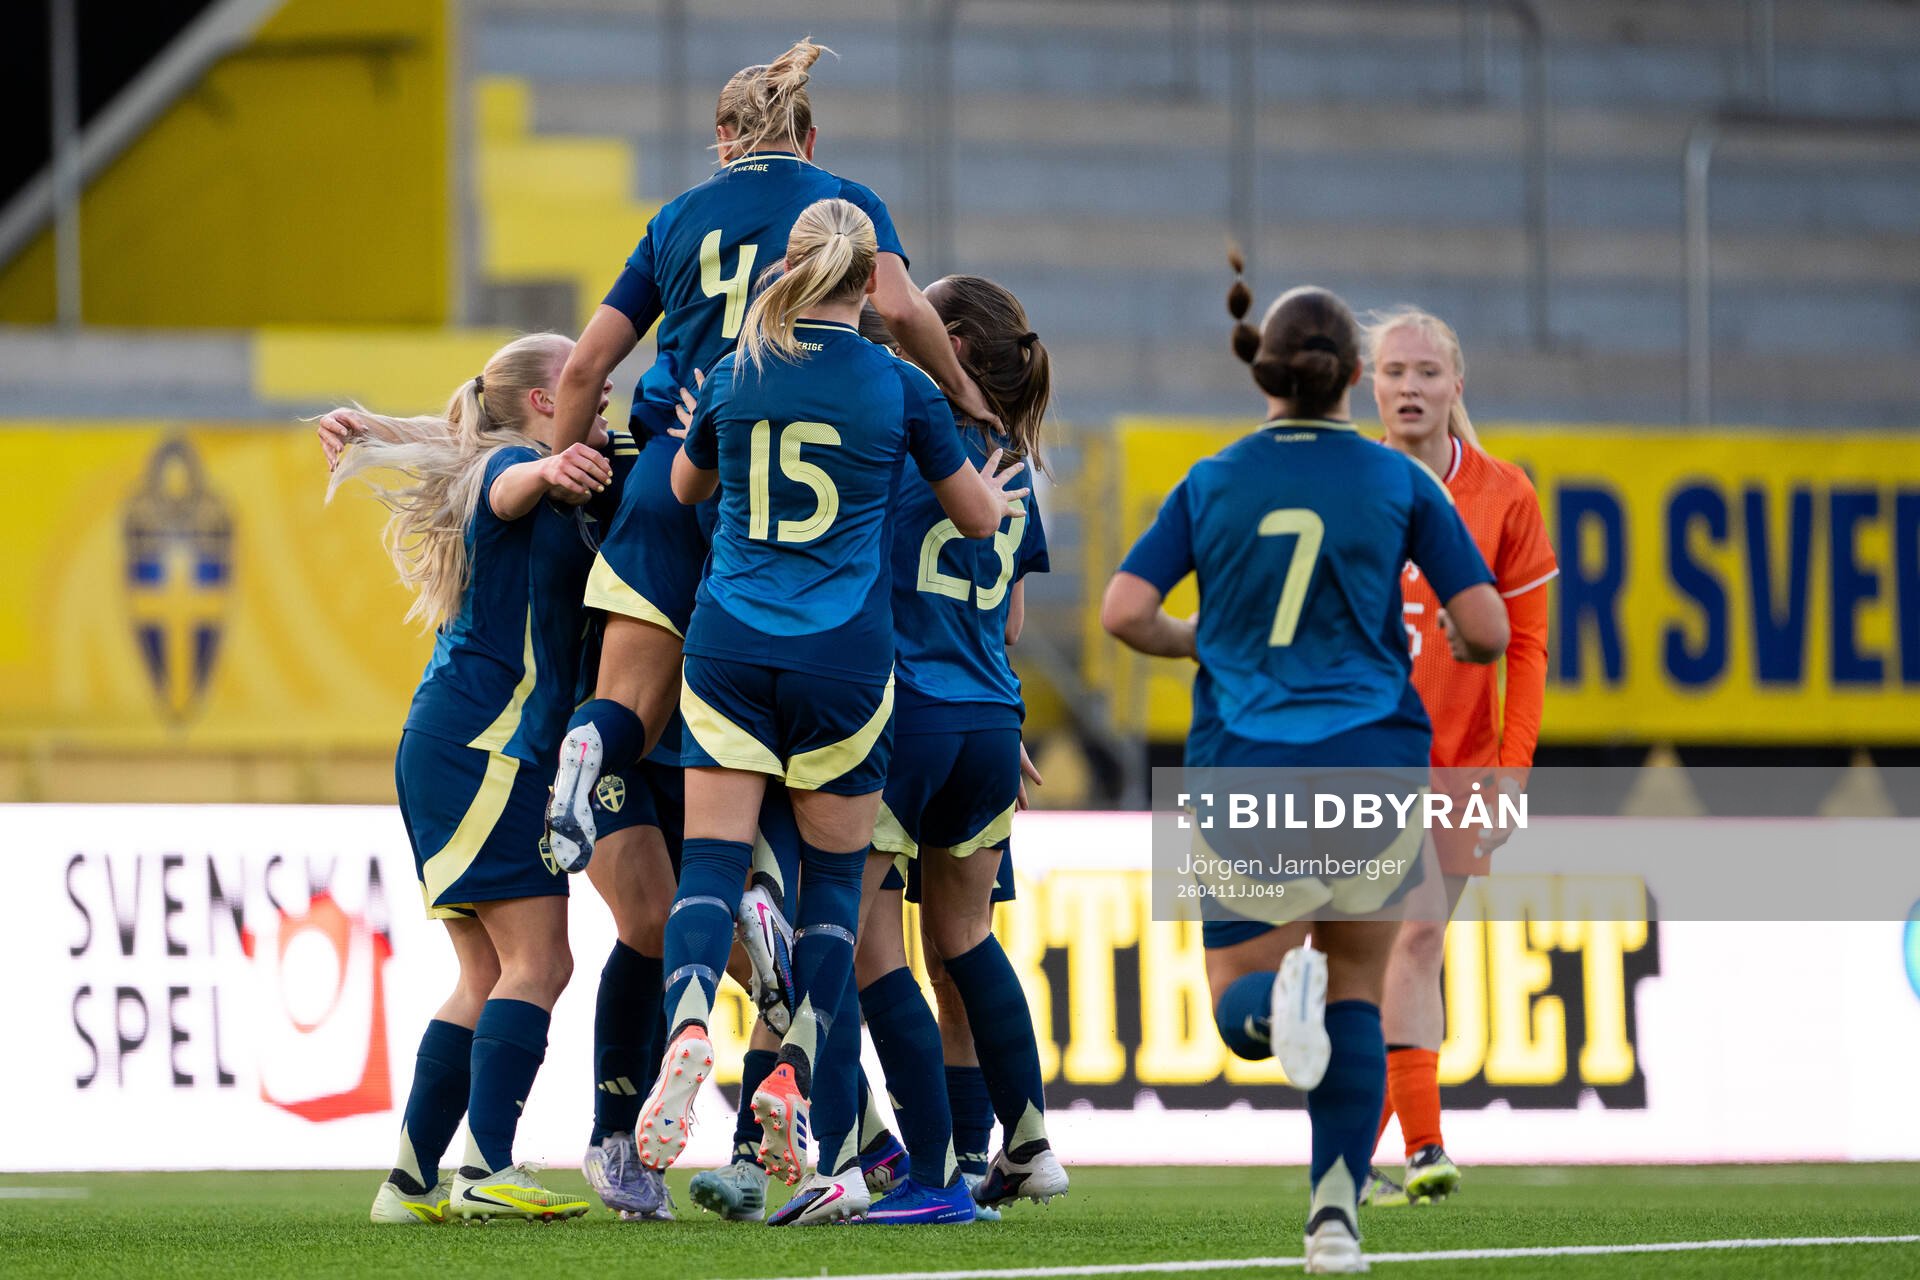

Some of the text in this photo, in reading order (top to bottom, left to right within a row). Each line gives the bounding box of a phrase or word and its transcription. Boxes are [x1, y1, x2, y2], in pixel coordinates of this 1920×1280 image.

[733, 164, 769, 173] SVERIGE
[700, 230, 757, 339] 4
[749, 419, 842, 543] 15
[1257, 509, 1325, 647] 7
[72, 985, 236, 1088] SPEL
